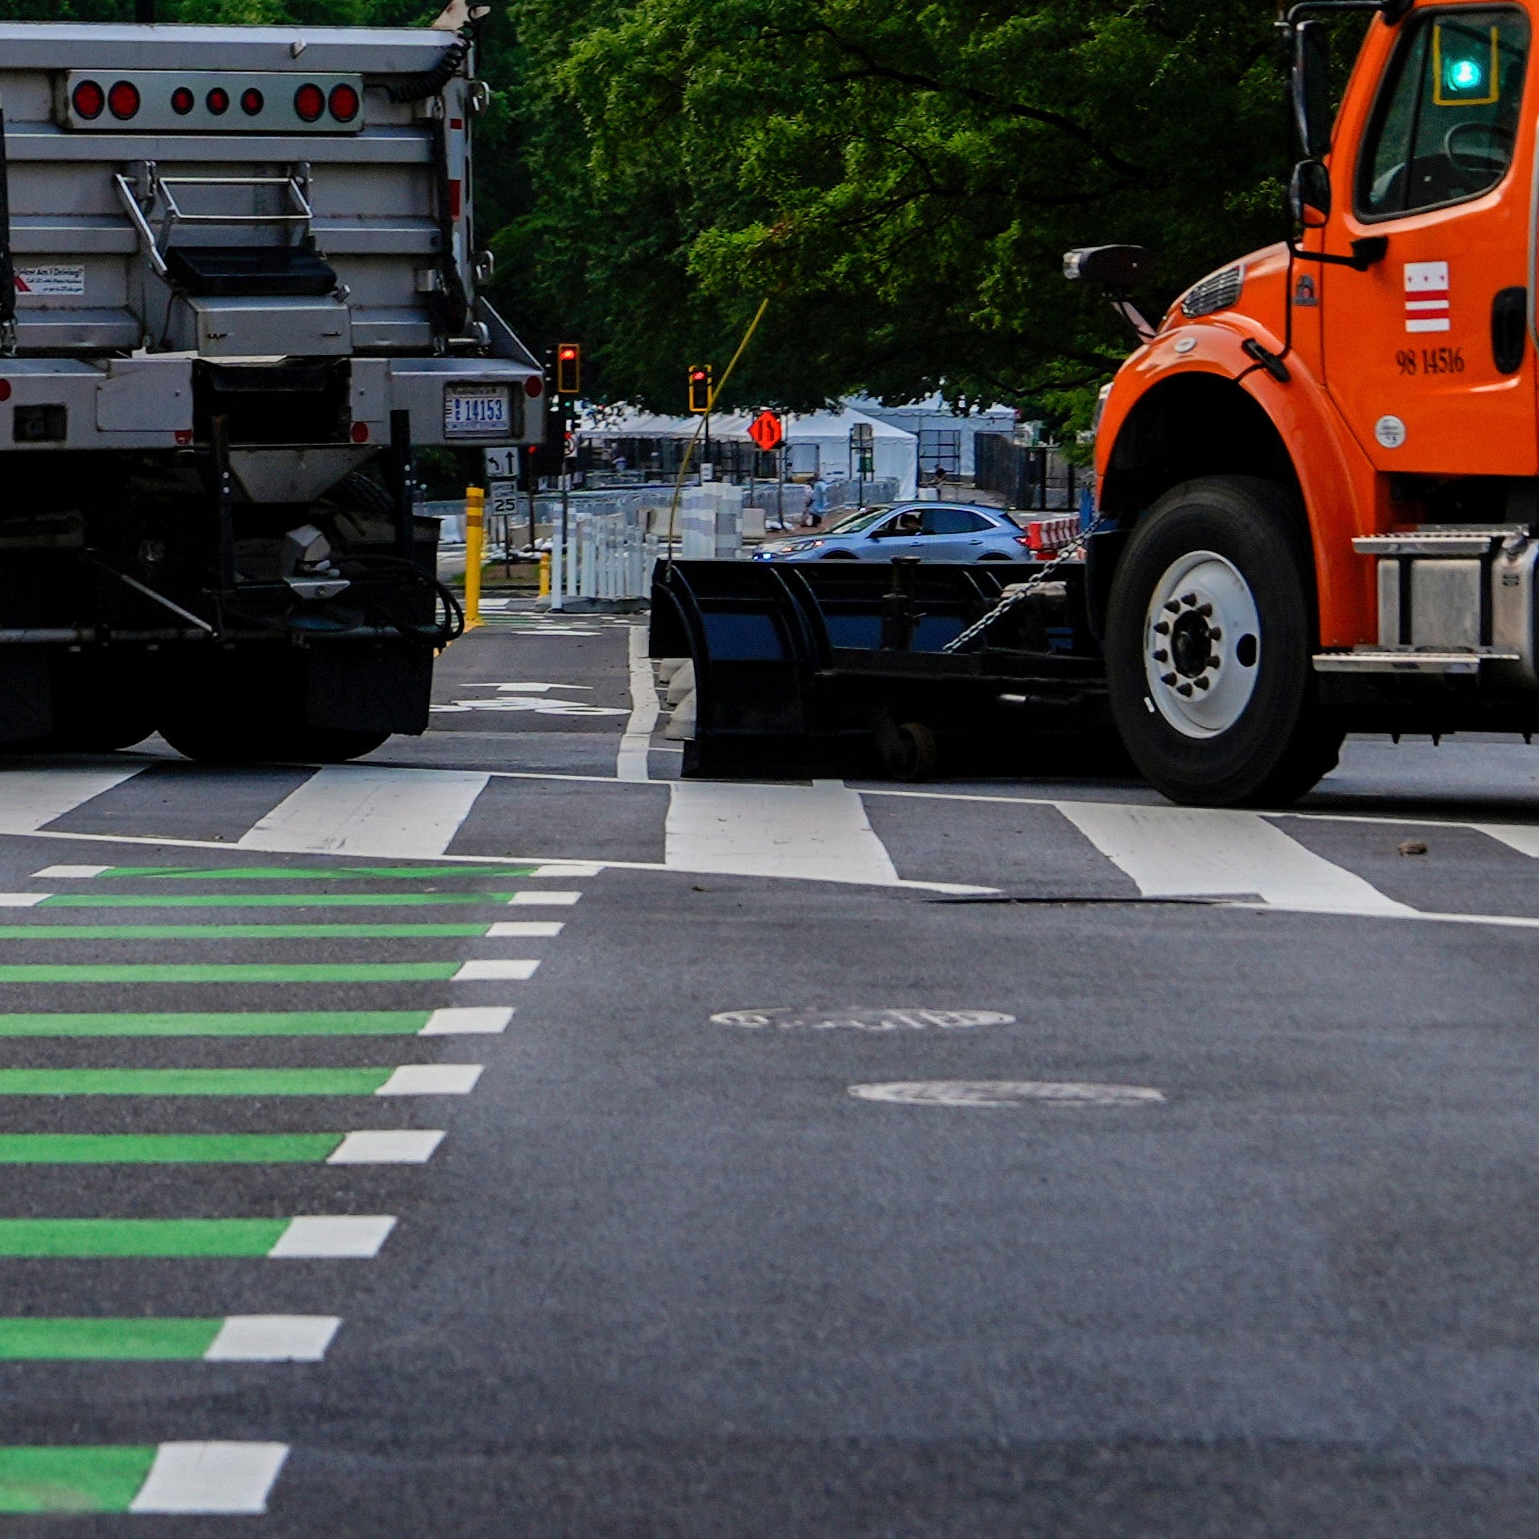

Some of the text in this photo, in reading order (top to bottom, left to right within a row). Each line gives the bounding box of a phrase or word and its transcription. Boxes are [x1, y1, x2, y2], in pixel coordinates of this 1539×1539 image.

[1395, 347, 1465, 376] 98 14516
[465, 399, 503, 422] 14153
[494, 498, 516, 511] 25
